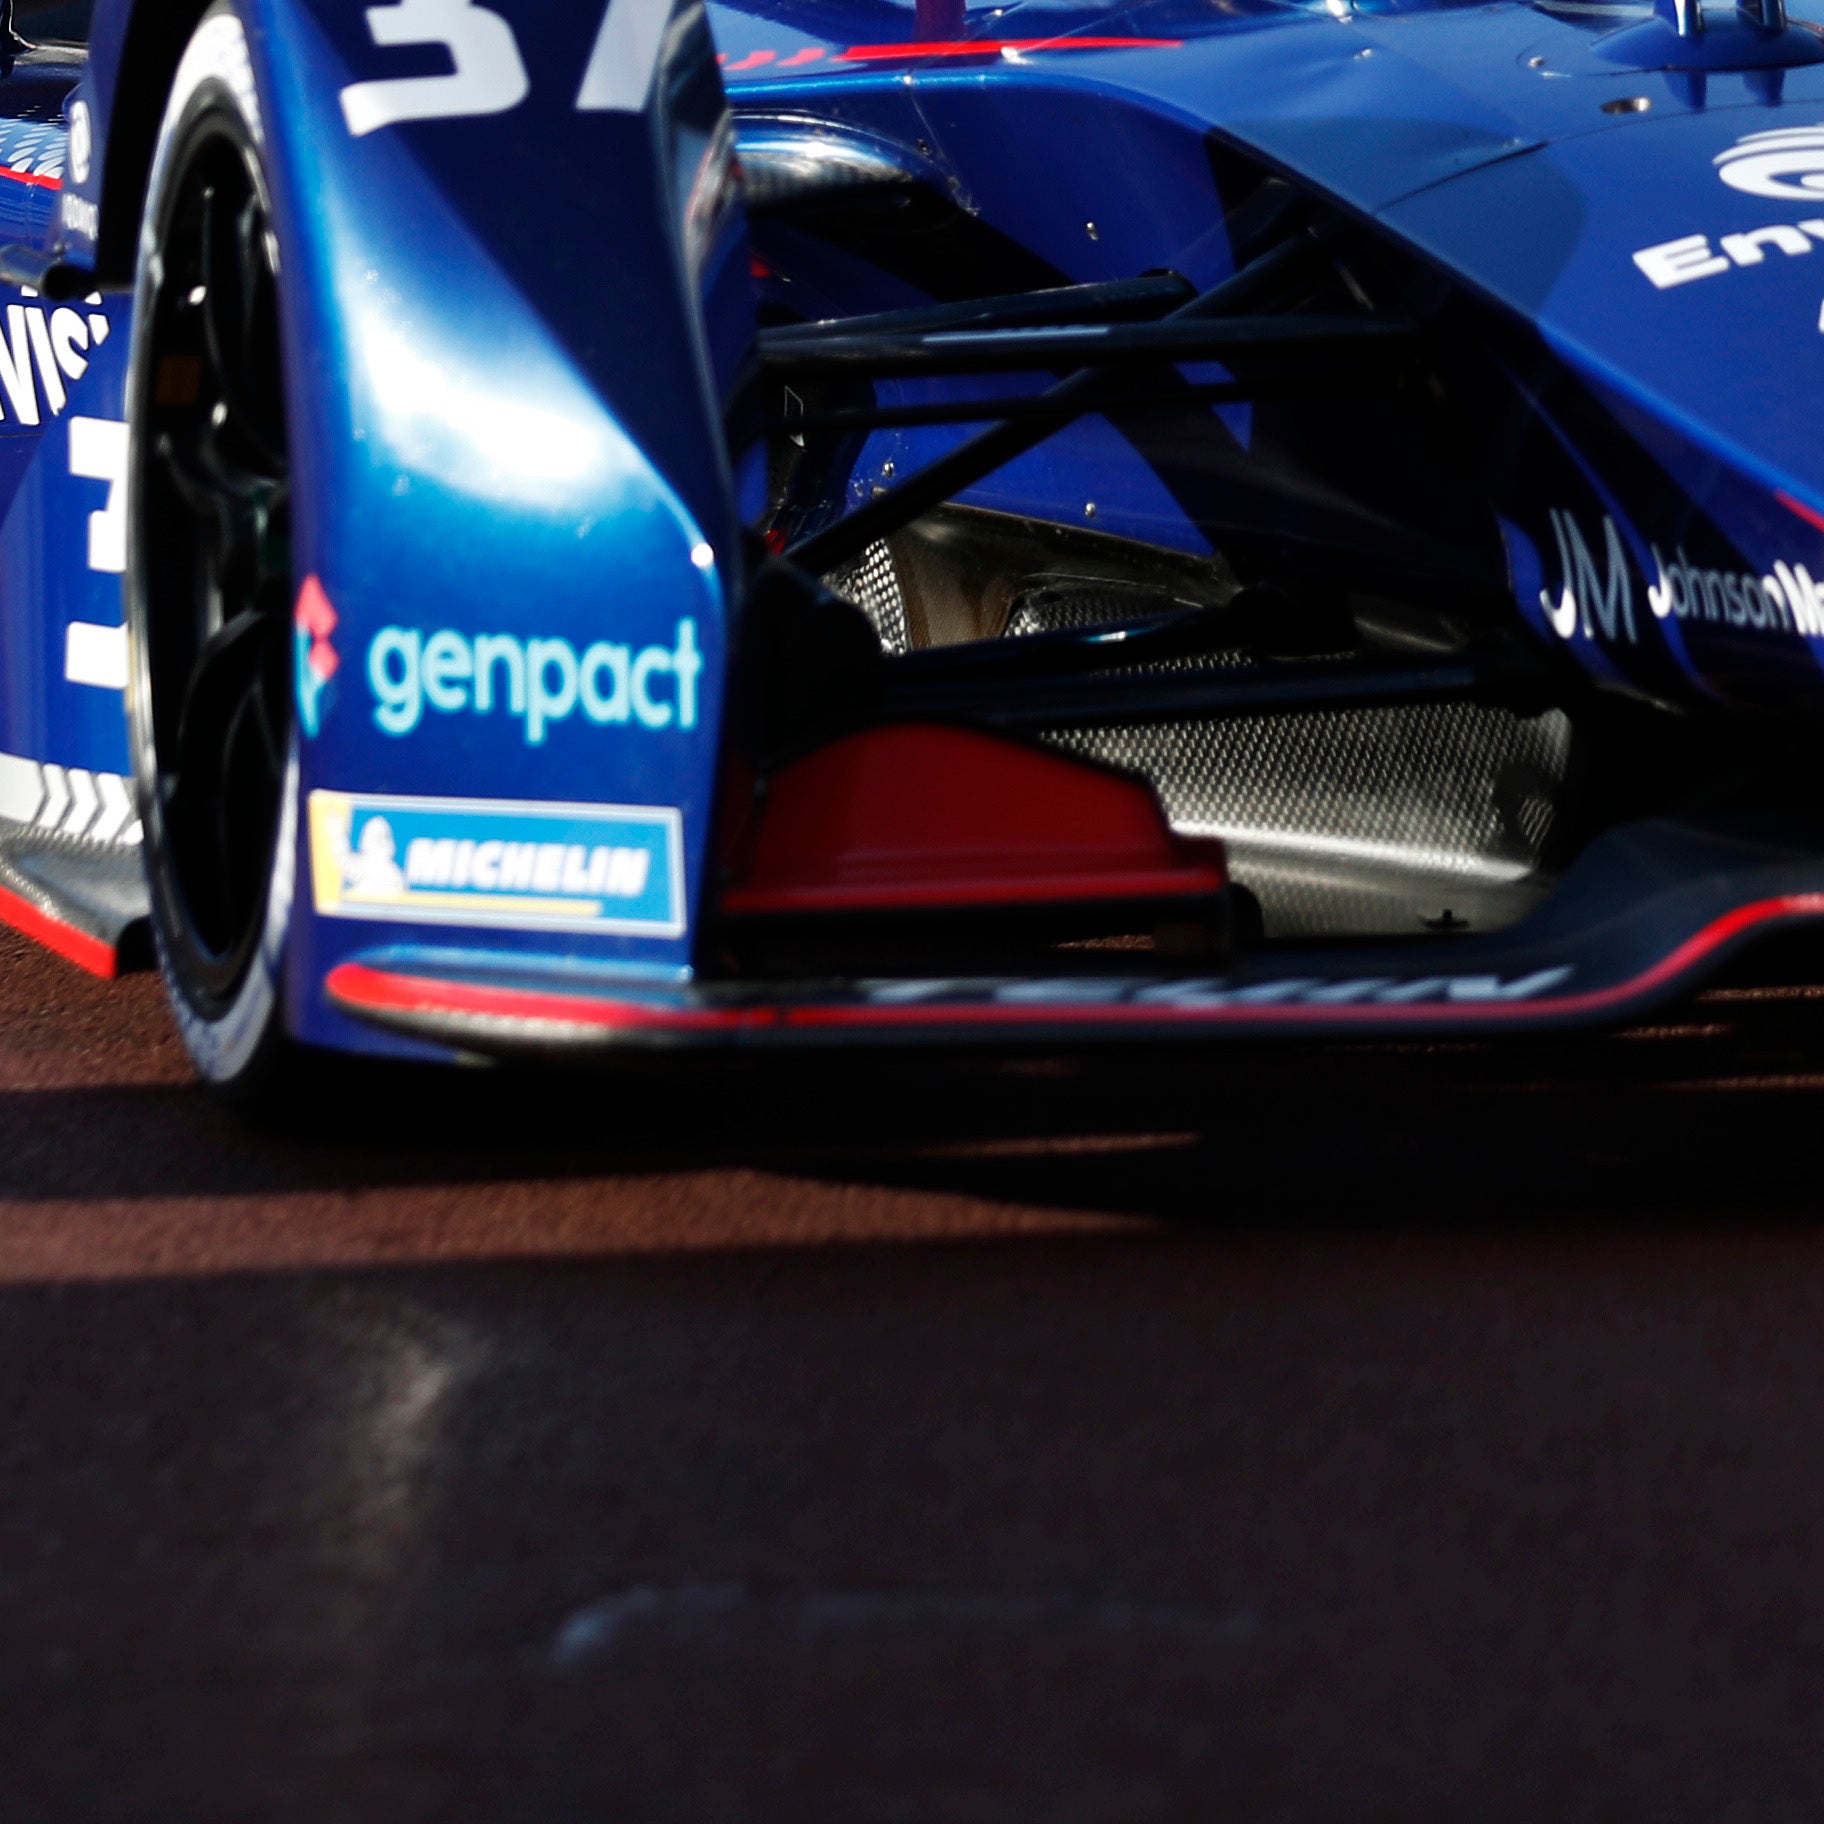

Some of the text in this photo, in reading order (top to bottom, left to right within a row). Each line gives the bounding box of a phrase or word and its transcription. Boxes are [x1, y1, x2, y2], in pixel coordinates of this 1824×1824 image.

[1540, 507, 1638, 644] JM
[368, 617, 702, 745] genpact
[406, 837, 651, 897] MICHELIN
